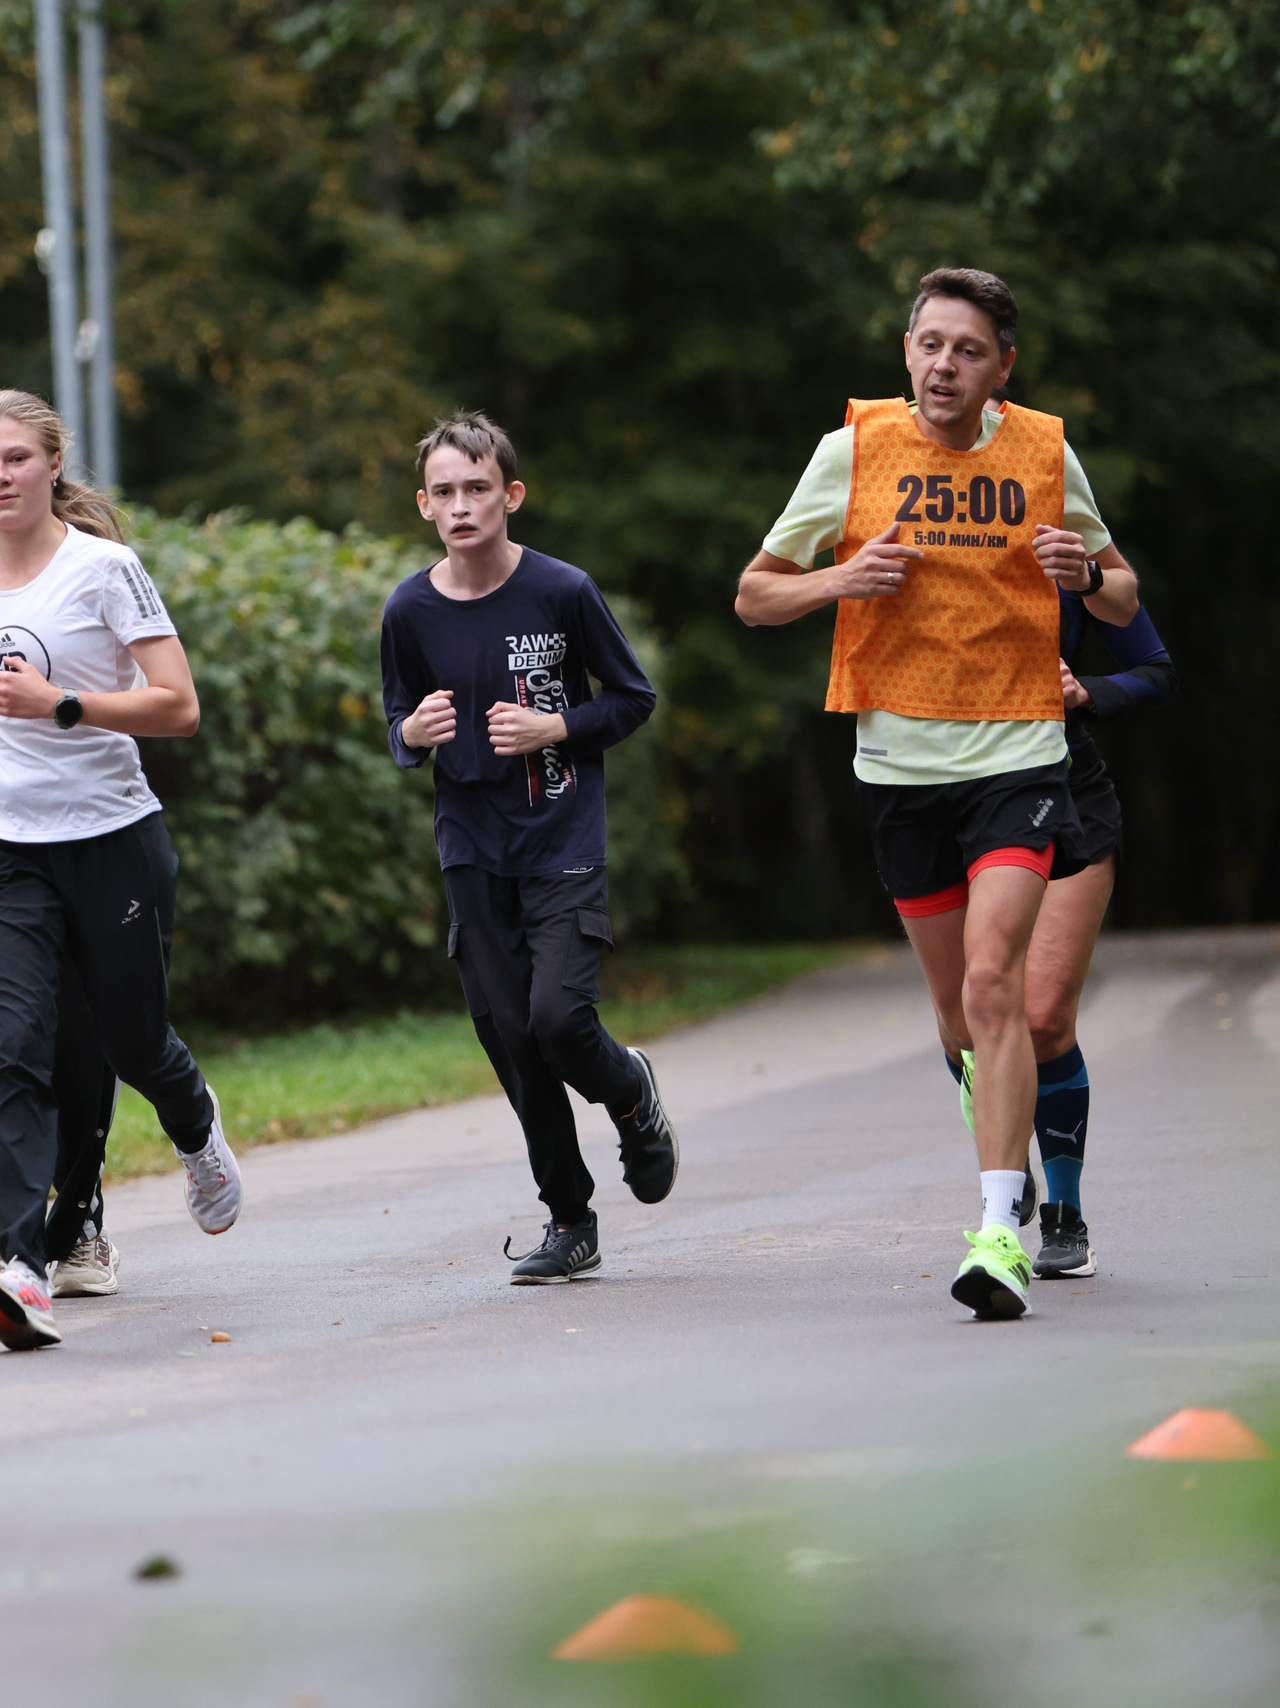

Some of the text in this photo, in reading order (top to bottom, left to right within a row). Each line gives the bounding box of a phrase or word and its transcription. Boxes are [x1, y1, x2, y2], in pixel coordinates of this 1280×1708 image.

[895, 474, 1026, 526] 25:00
[913, 530, 946, 546] 5:00
[505, 633, 549, 653] RAW
[514, 651, 563, 668] DENIM
[518, 679, 528, 705] URBAN
